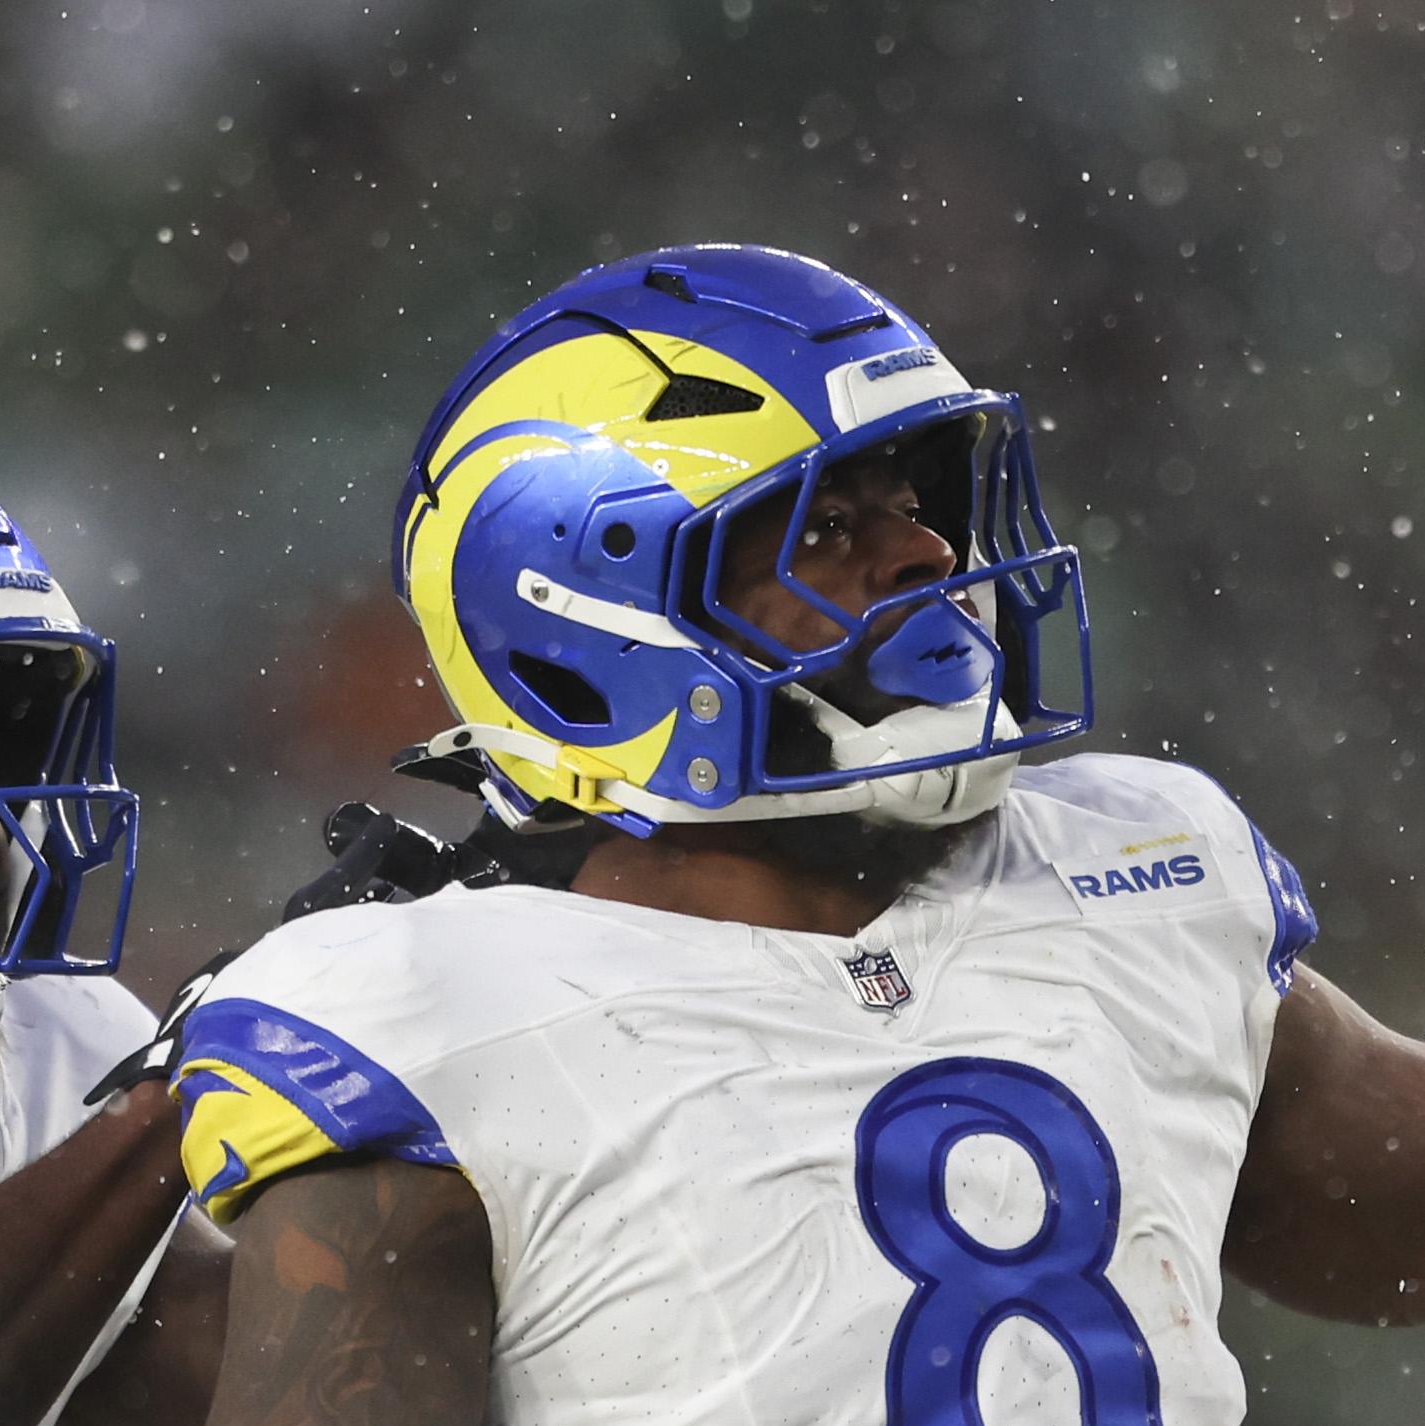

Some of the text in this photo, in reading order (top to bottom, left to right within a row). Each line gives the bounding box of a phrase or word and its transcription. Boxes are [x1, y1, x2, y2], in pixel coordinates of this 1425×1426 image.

[861, 348, 935, 381] RAMS
[1070, 855, 1205, 898] RAMS
[859, 975, 906, 1003] NFL
